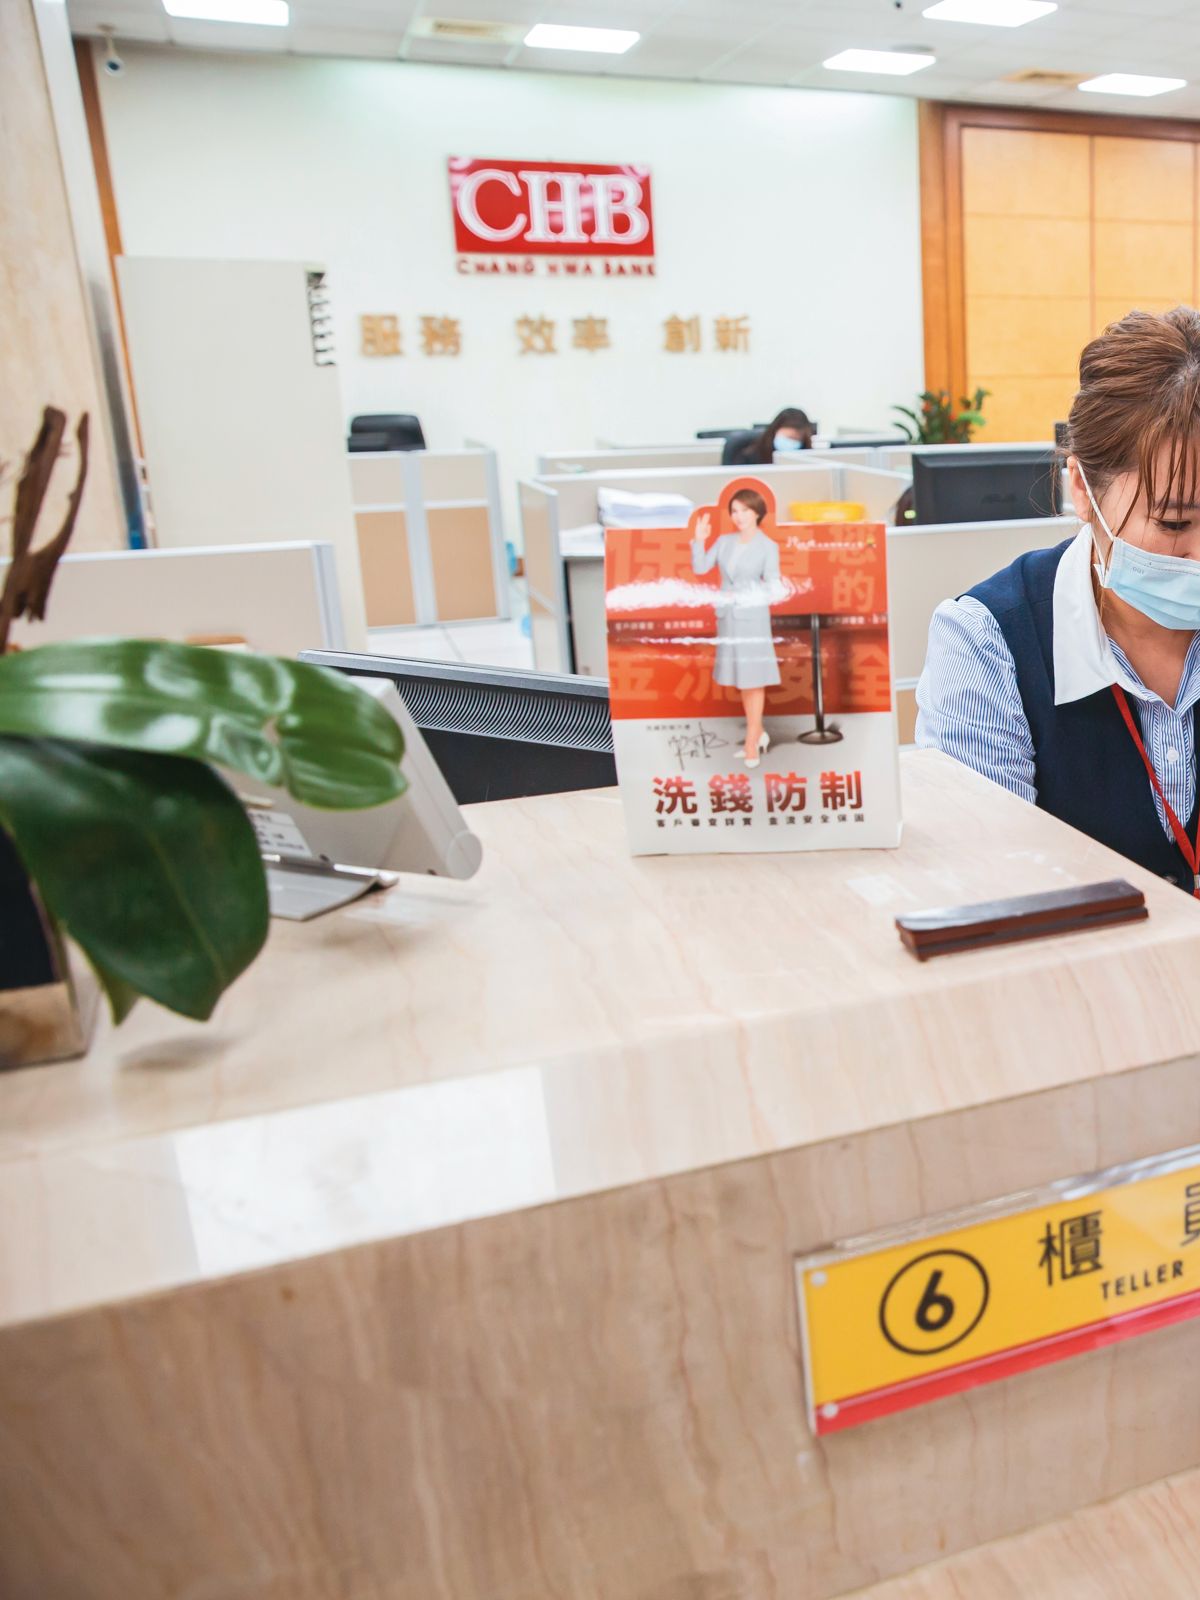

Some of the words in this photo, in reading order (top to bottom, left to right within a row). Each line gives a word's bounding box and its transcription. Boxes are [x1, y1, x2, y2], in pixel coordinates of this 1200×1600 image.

[457, 168, 650, 245] CHB
[652, 769, 863, 815] 洗錢防制
[914, 1269, 956, 1333] 6
[1101, 1259, 1185, 1300] TELLER
